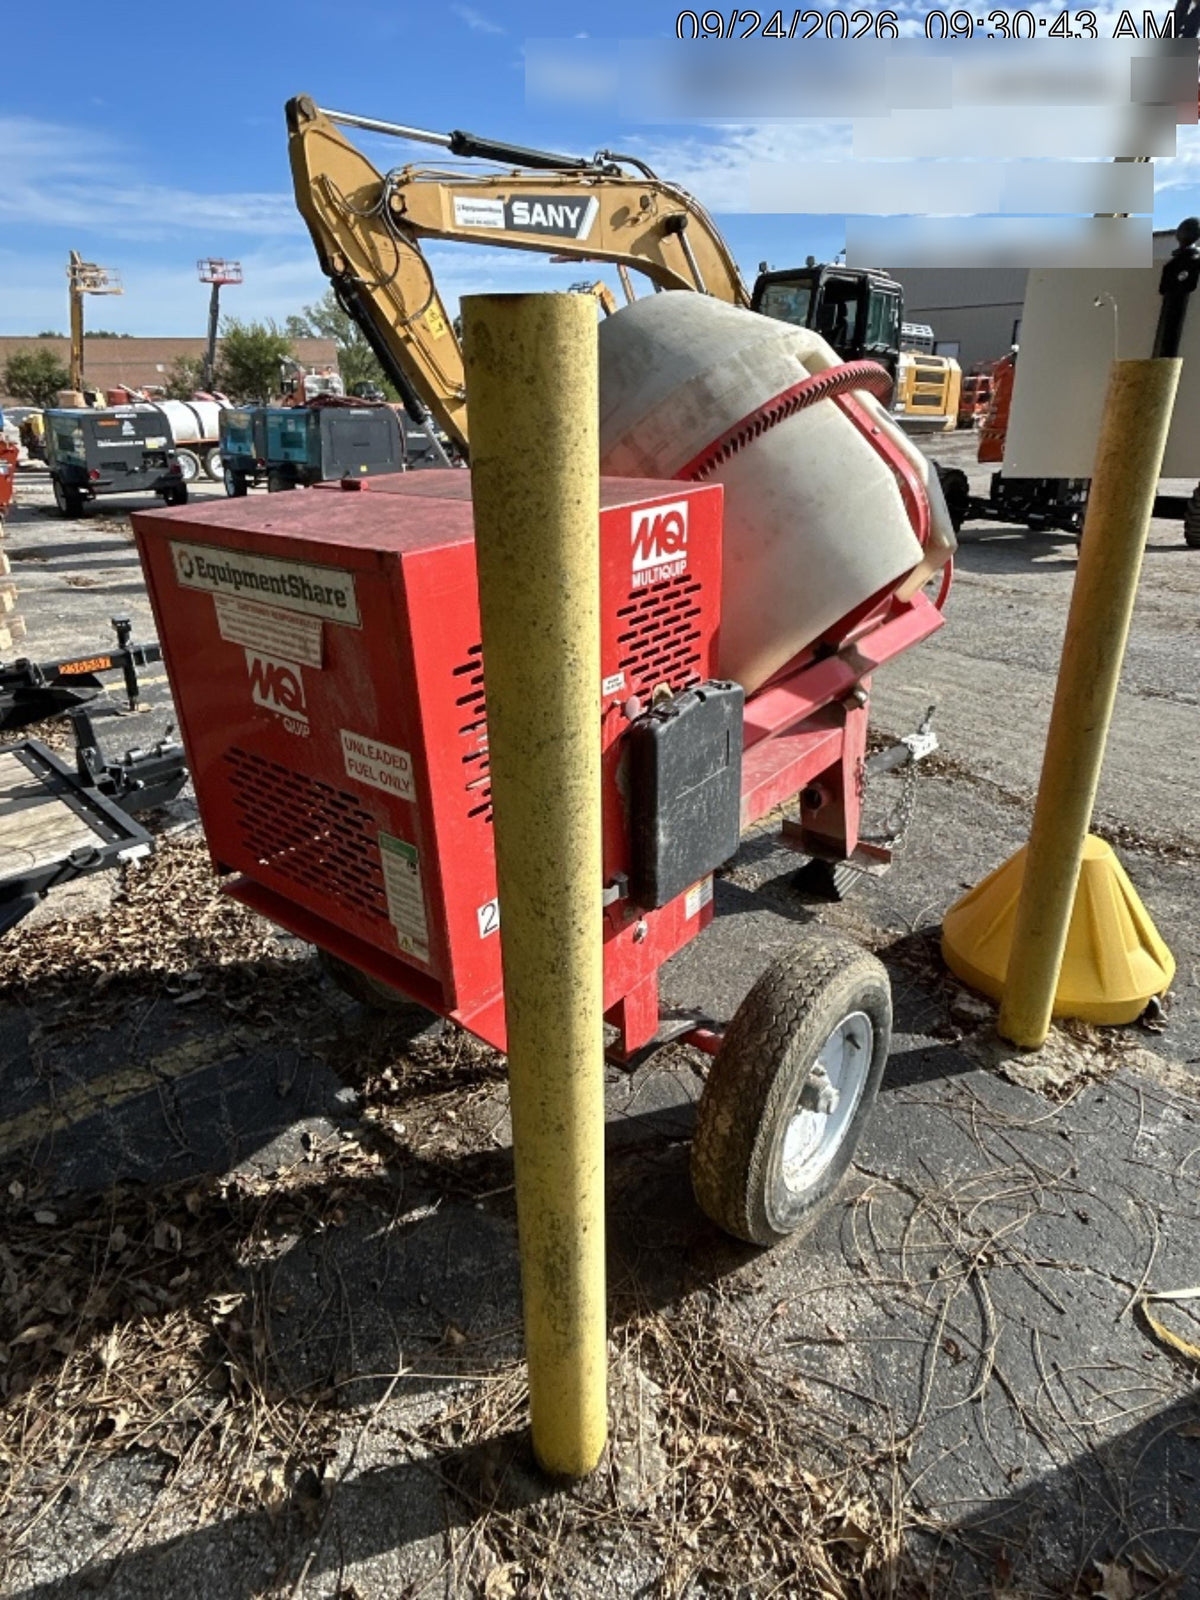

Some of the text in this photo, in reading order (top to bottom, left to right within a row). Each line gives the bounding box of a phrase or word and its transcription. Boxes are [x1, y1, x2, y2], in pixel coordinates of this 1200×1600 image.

[511, 201, 581, 228] SANY
[631, 506, 687, 563] MQ
[194, 556, 347, 609] EquipmentShare
[632, 560, 687, 588] MULTIQUIP
[344, 737, 408, 771] UNLEADED
[348, 758, 409, 792] FUEL ONLY
